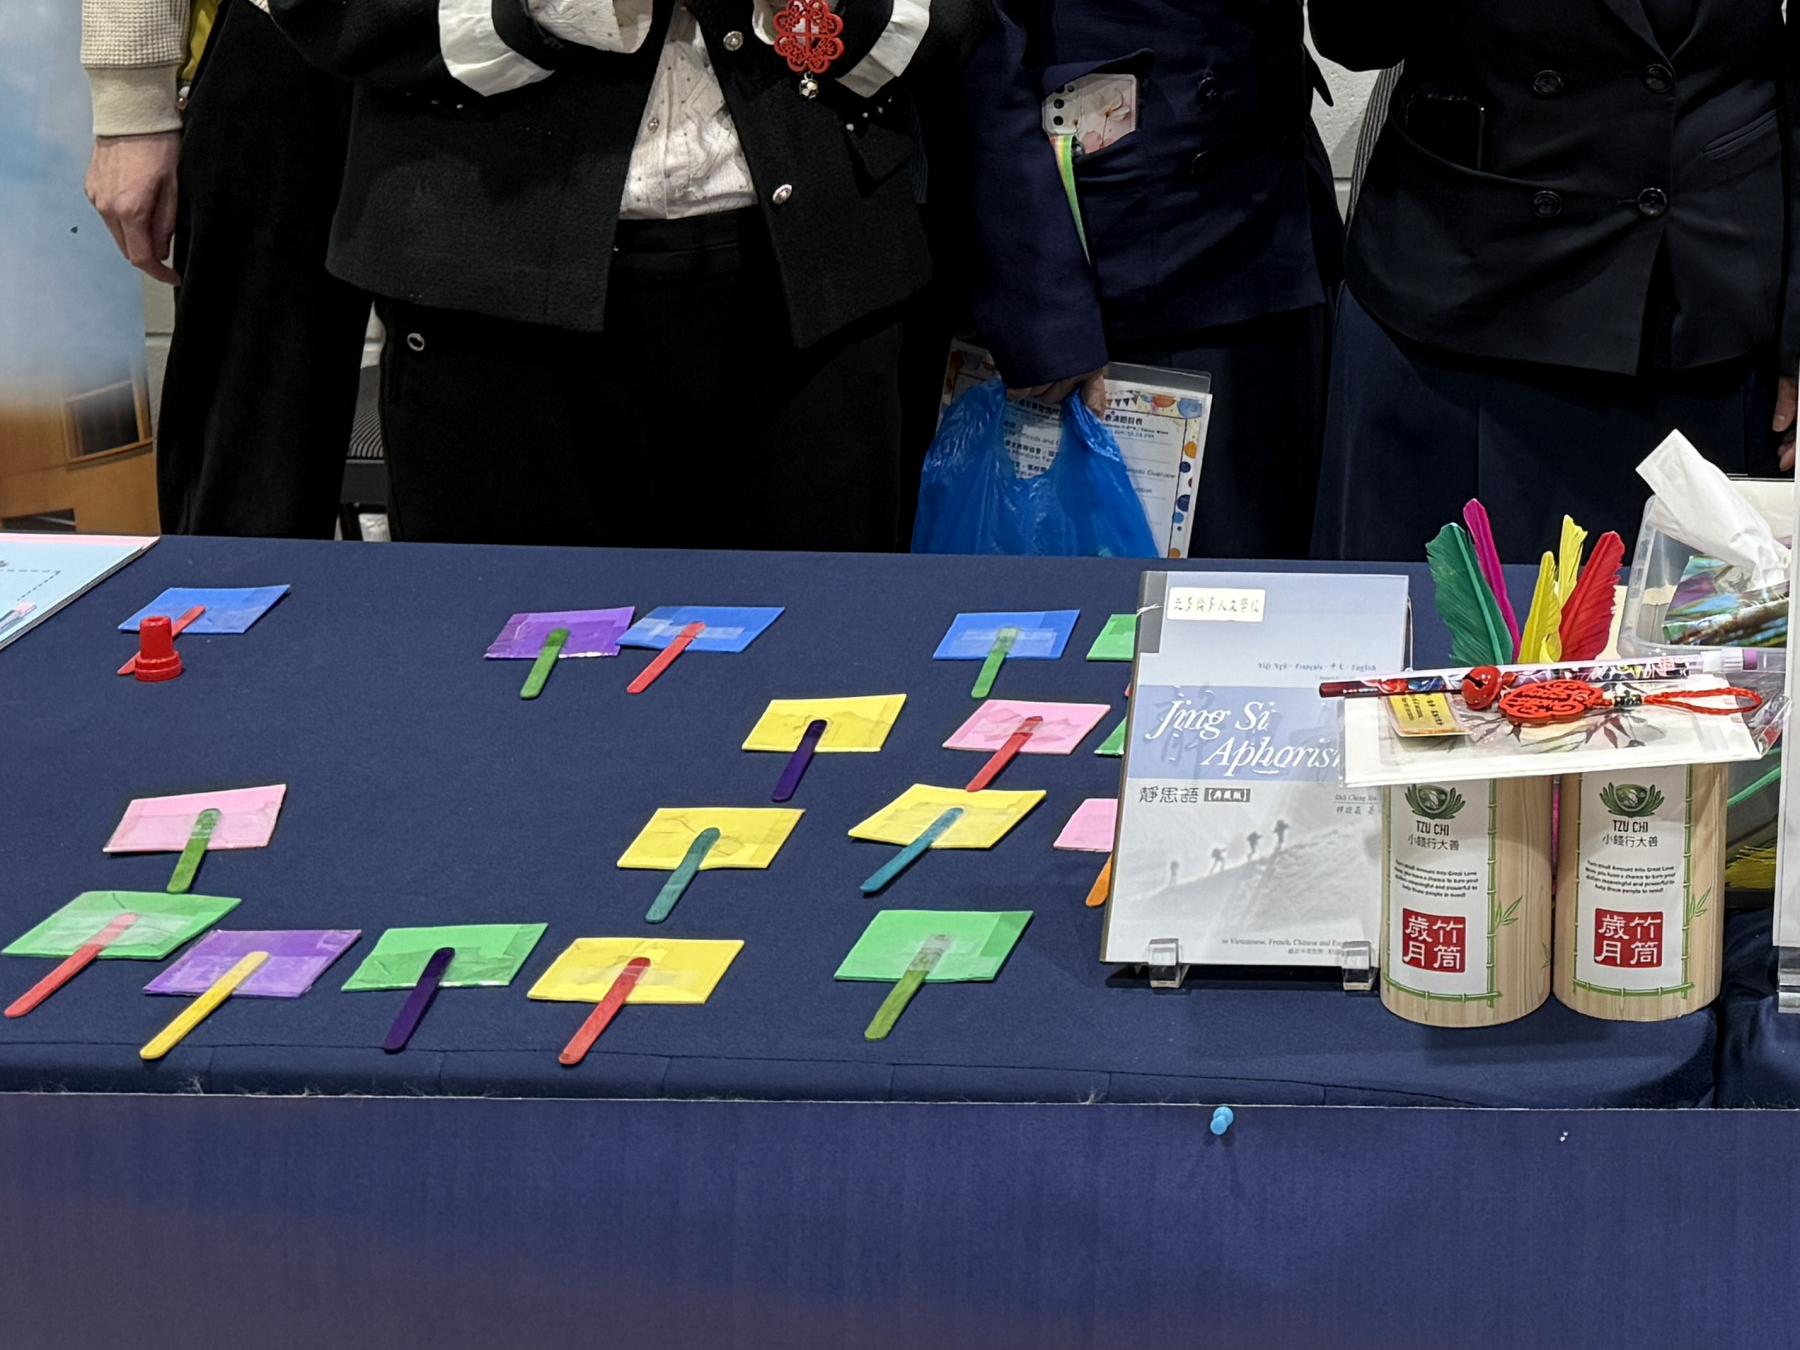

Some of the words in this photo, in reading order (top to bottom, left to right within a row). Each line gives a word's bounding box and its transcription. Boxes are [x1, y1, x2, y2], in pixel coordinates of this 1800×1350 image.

[1145, 699, 1231, 740] Jing
[1235, 700, 1276, 732] Si
[1200, 736, 1340, 777] Aphoris
[1416, 820, 1431, 834] TZU
[1434, 823, 1449, 836] CHI
[1613, 820, 1629, 832] TZU
[1632, 821, 1648, 833] CHI
